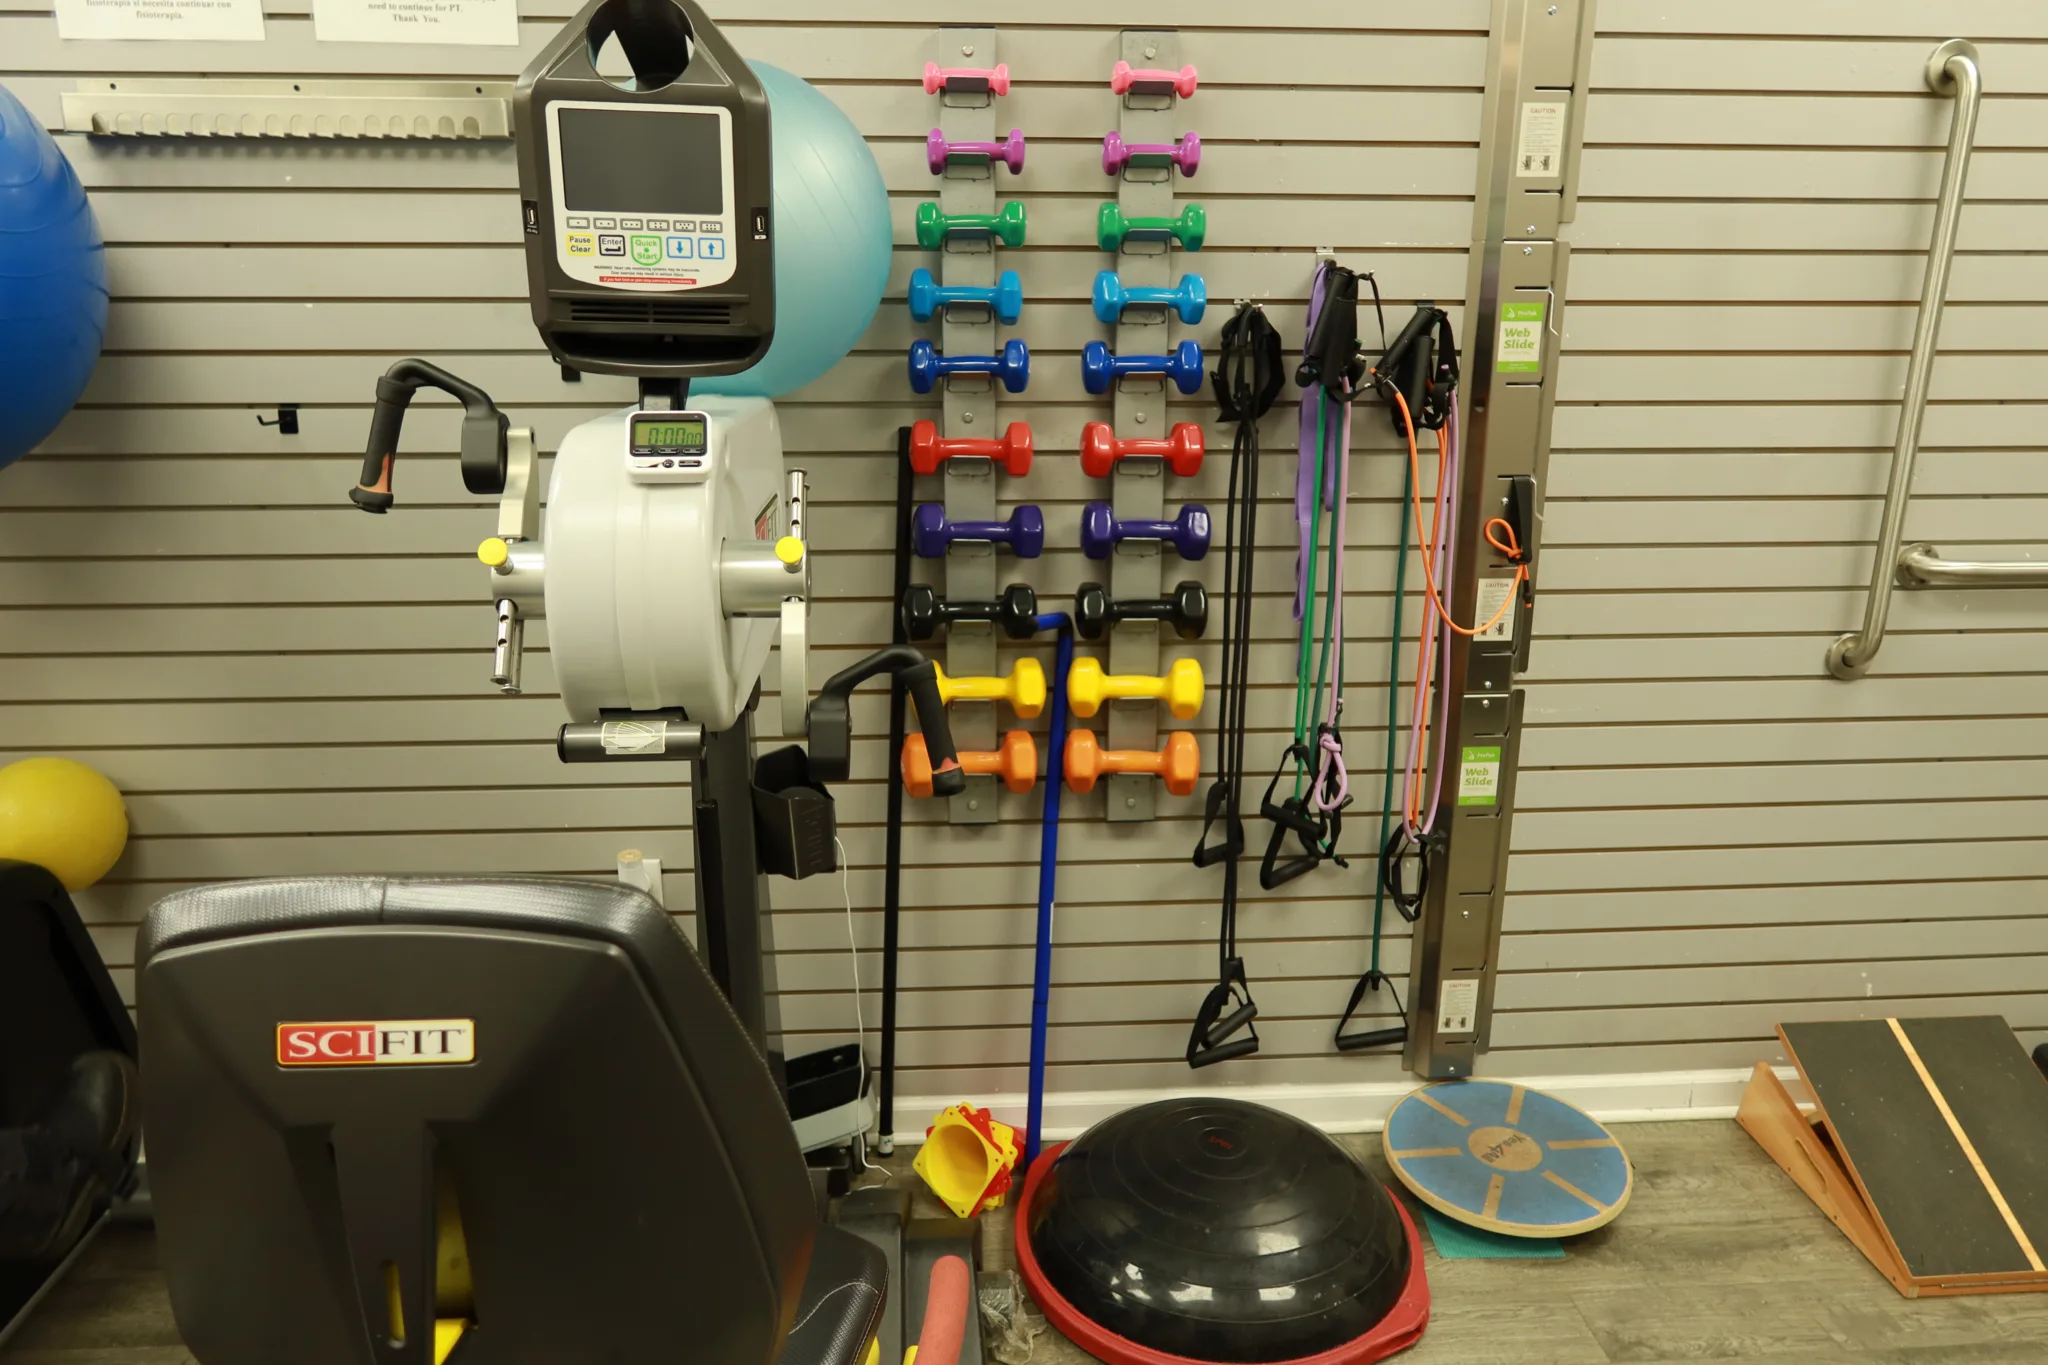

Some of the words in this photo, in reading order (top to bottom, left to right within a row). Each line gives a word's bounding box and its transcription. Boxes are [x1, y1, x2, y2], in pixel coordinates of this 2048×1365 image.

[176, 0, 214, 8] continuar
[398, 3, 433, 11] continue
[449, 4, 463, 12] PT.
[392, 14, 419, 22] Thank
[423, 14, 440, 23] You.
[569, 235, 591, 244] Pause
[601, 237, 623, 245] Enter
[635, 239, 658, 247] Quick
[570, 245, 591, 253] Clear
[637, 252, 658, 260] Start
[1504, 328, 1531, 337] Web
[1504, 340, 1535, 349] Slide
[1465, 768, 1489, 776] Web
[1464, 777, 1493, 786] Slide
[288, 1028, 463, 1058] SCIFIT
